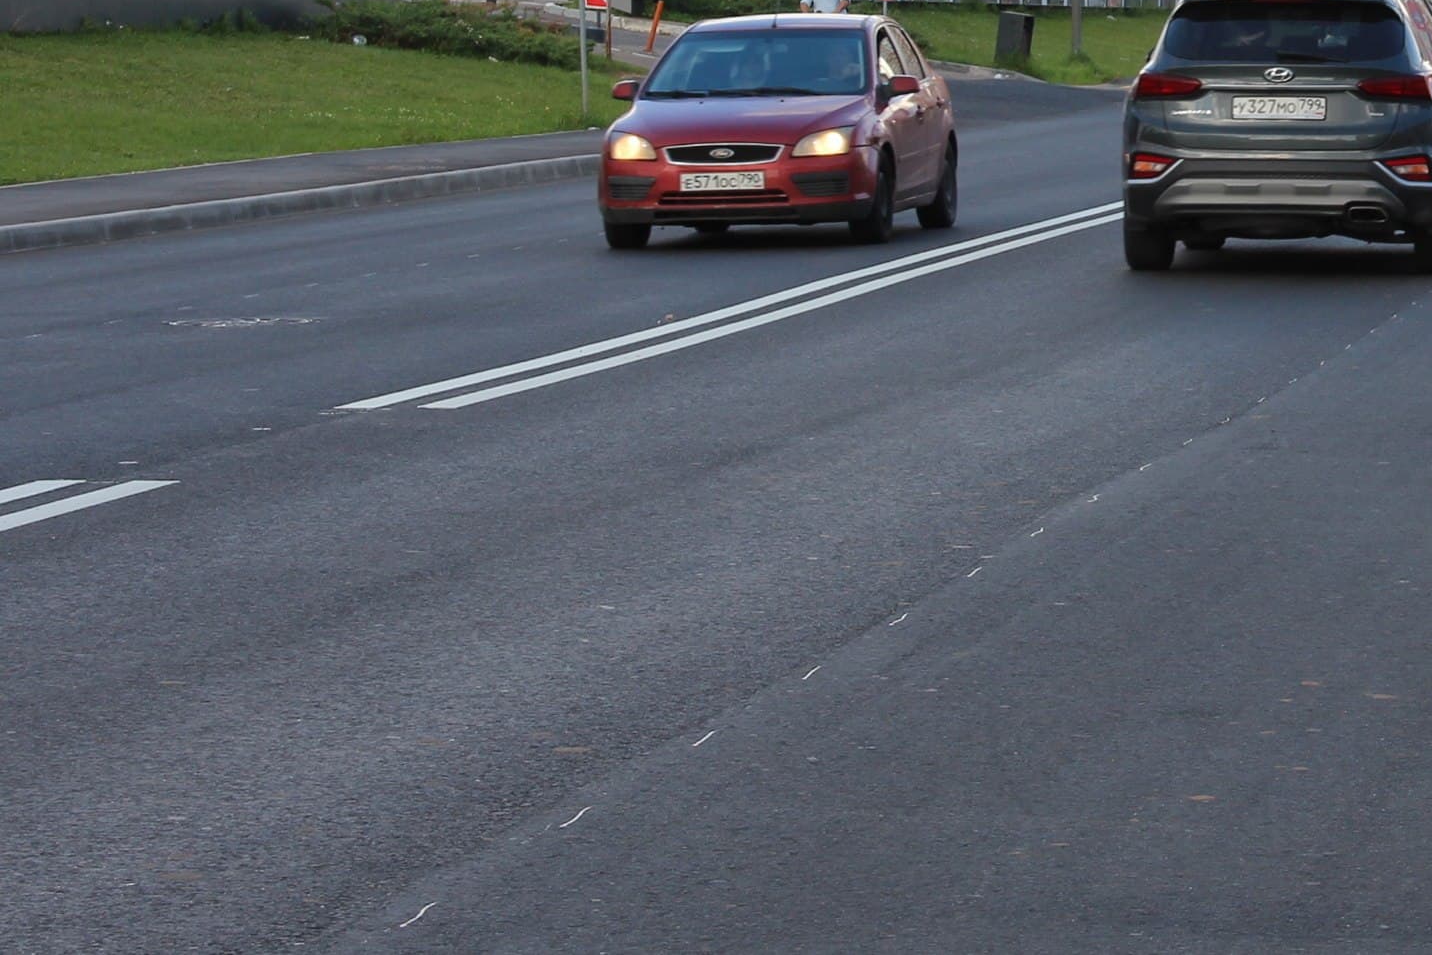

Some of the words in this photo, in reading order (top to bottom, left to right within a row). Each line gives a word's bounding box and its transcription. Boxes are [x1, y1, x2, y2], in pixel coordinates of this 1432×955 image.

[1237, 99, 1297, 115] У327МО
[1299, 98, 1322, 111] 799
[684, 175, 737, 190] Е571ОС
[739, 173, 761, 184] 790
